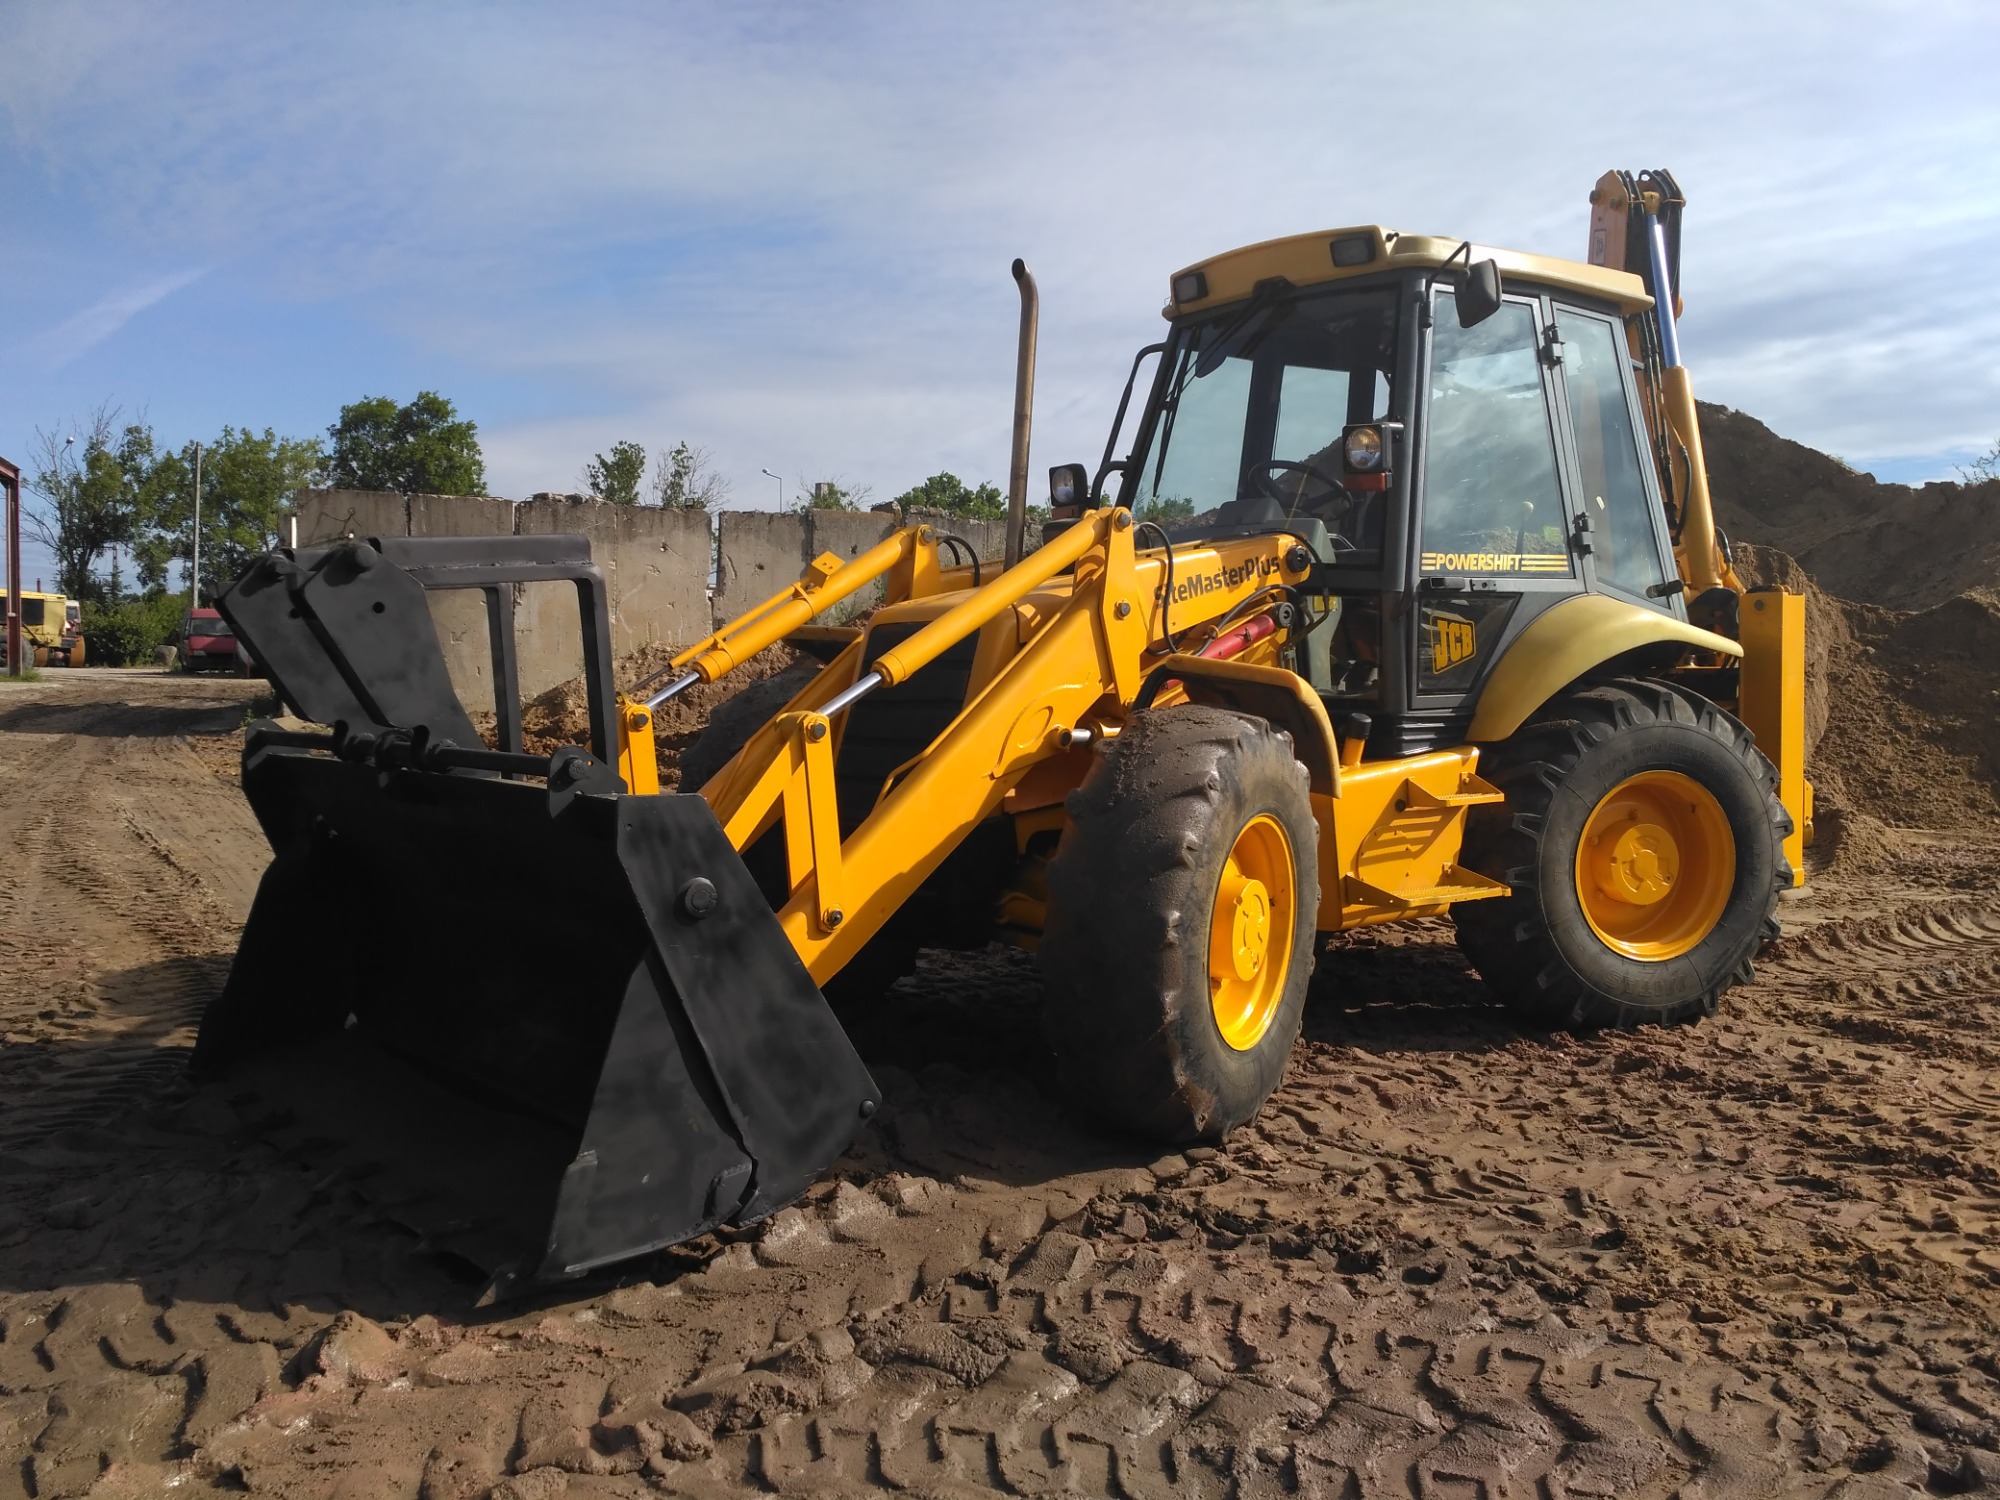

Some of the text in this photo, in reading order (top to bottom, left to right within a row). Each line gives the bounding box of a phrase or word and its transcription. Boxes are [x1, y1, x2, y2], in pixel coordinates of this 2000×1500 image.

[1153, 554, 1281, 609] SteMasterPlus
[1435, 553, 1522, 571] POWERSHIFT
[1434, 619, 1473, 671] JCB
